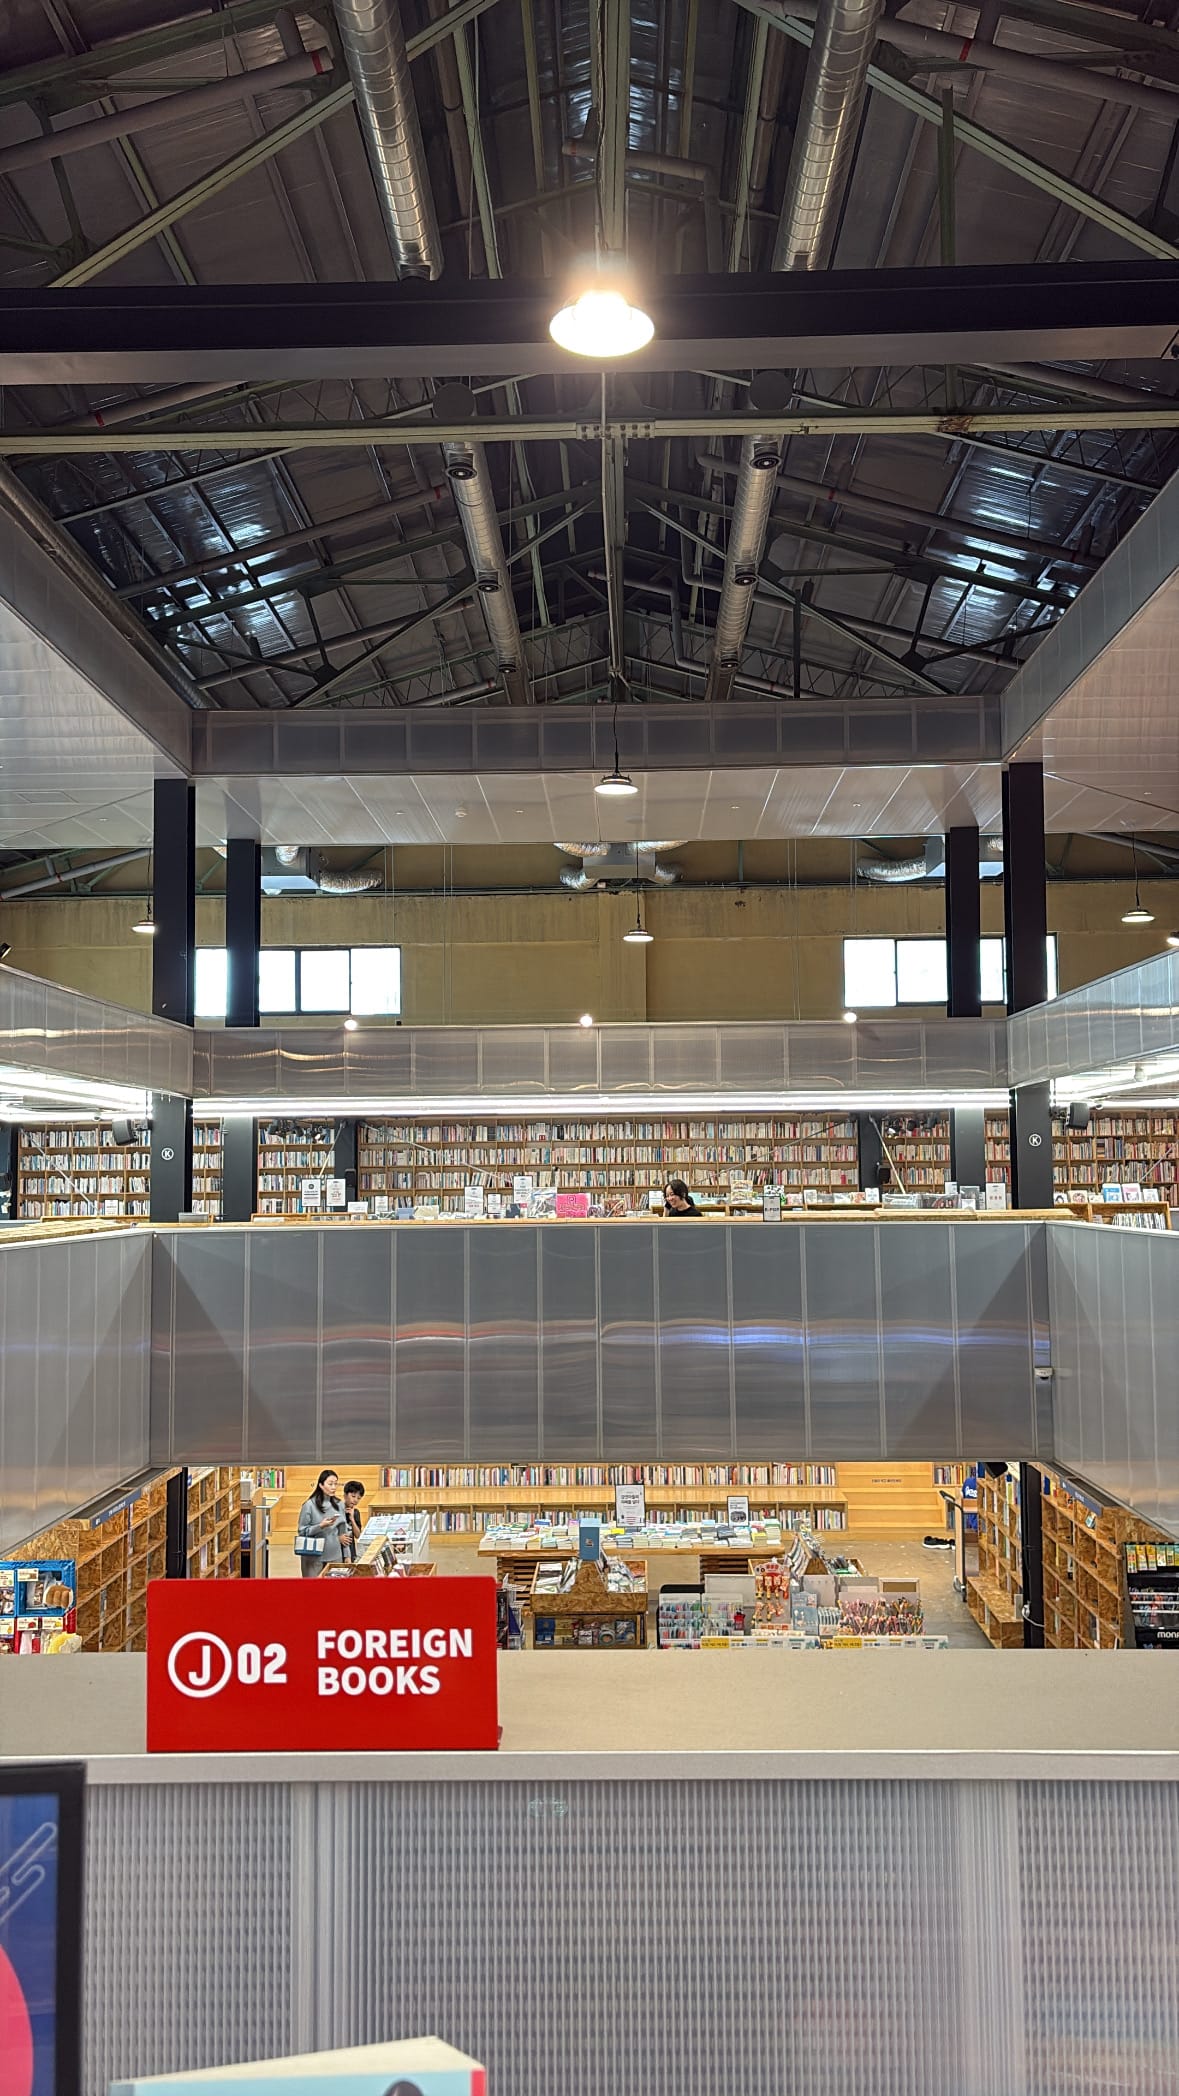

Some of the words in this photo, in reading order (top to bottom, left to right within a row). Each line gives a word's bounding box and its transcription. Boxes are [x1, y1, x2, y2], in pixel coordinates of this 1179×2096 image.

[317, 1628, 473, 1659] FOREIGN
[237, 1643, 288, 1684] 02
[318, 1665, 441, 1696] BOOKS
